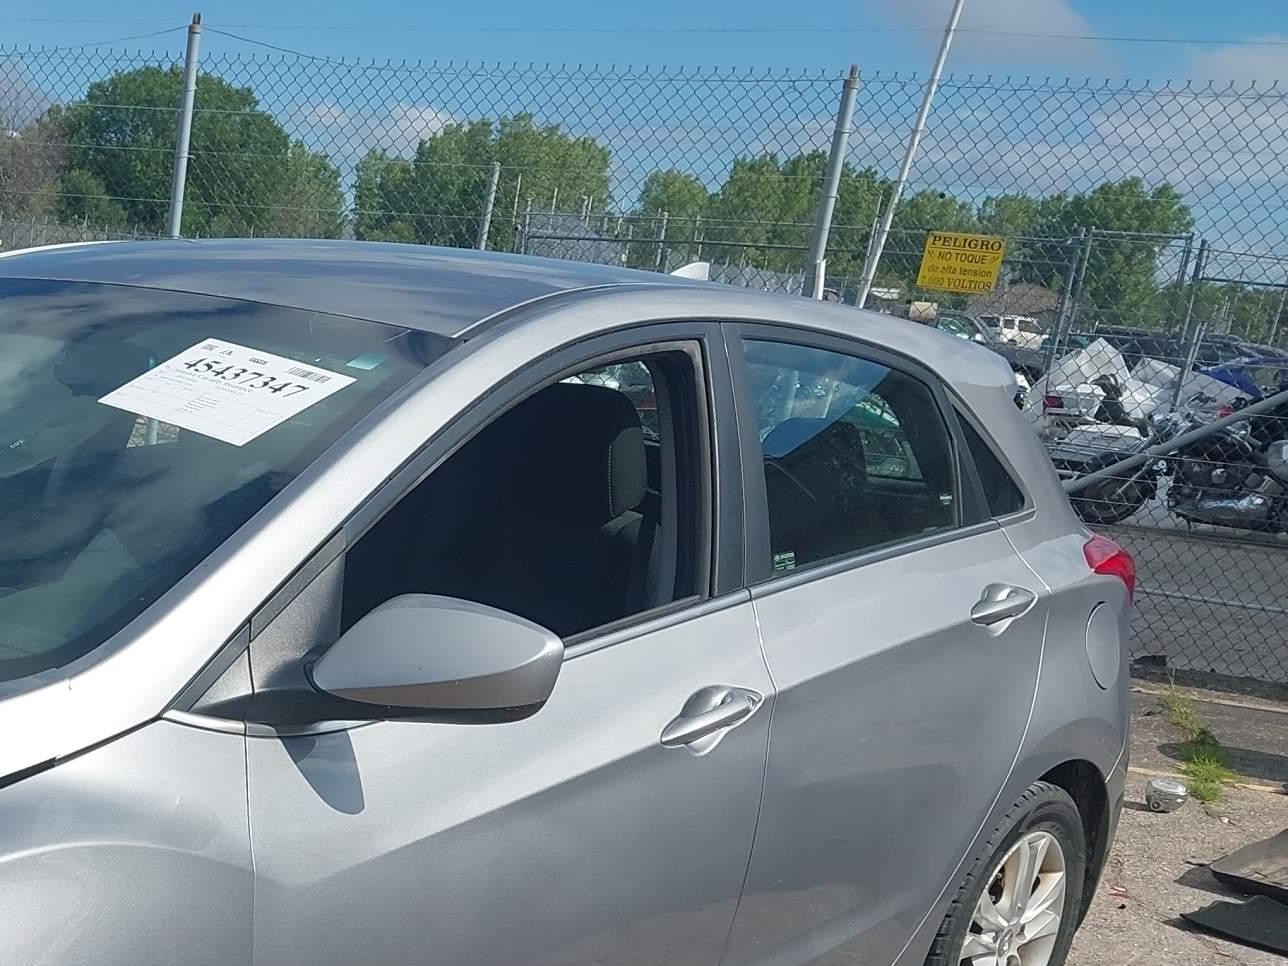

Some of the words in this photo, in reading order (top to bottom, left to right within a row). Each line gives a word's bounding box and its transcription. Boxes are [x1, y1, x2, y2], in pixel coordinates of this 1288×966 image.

[932, 235, 1002, 252] PELIGRO
[937, 251, 952, 260] NO
[955, 252, 988, 264] TOQUE
[927, 263, 939, 273] de
[940, 265, 957, 275] alta
[959, 266, 993, 278] tension
[947, 277, 992, 291] VOLTIOS
[184, 358, 310, 397] 45437347
